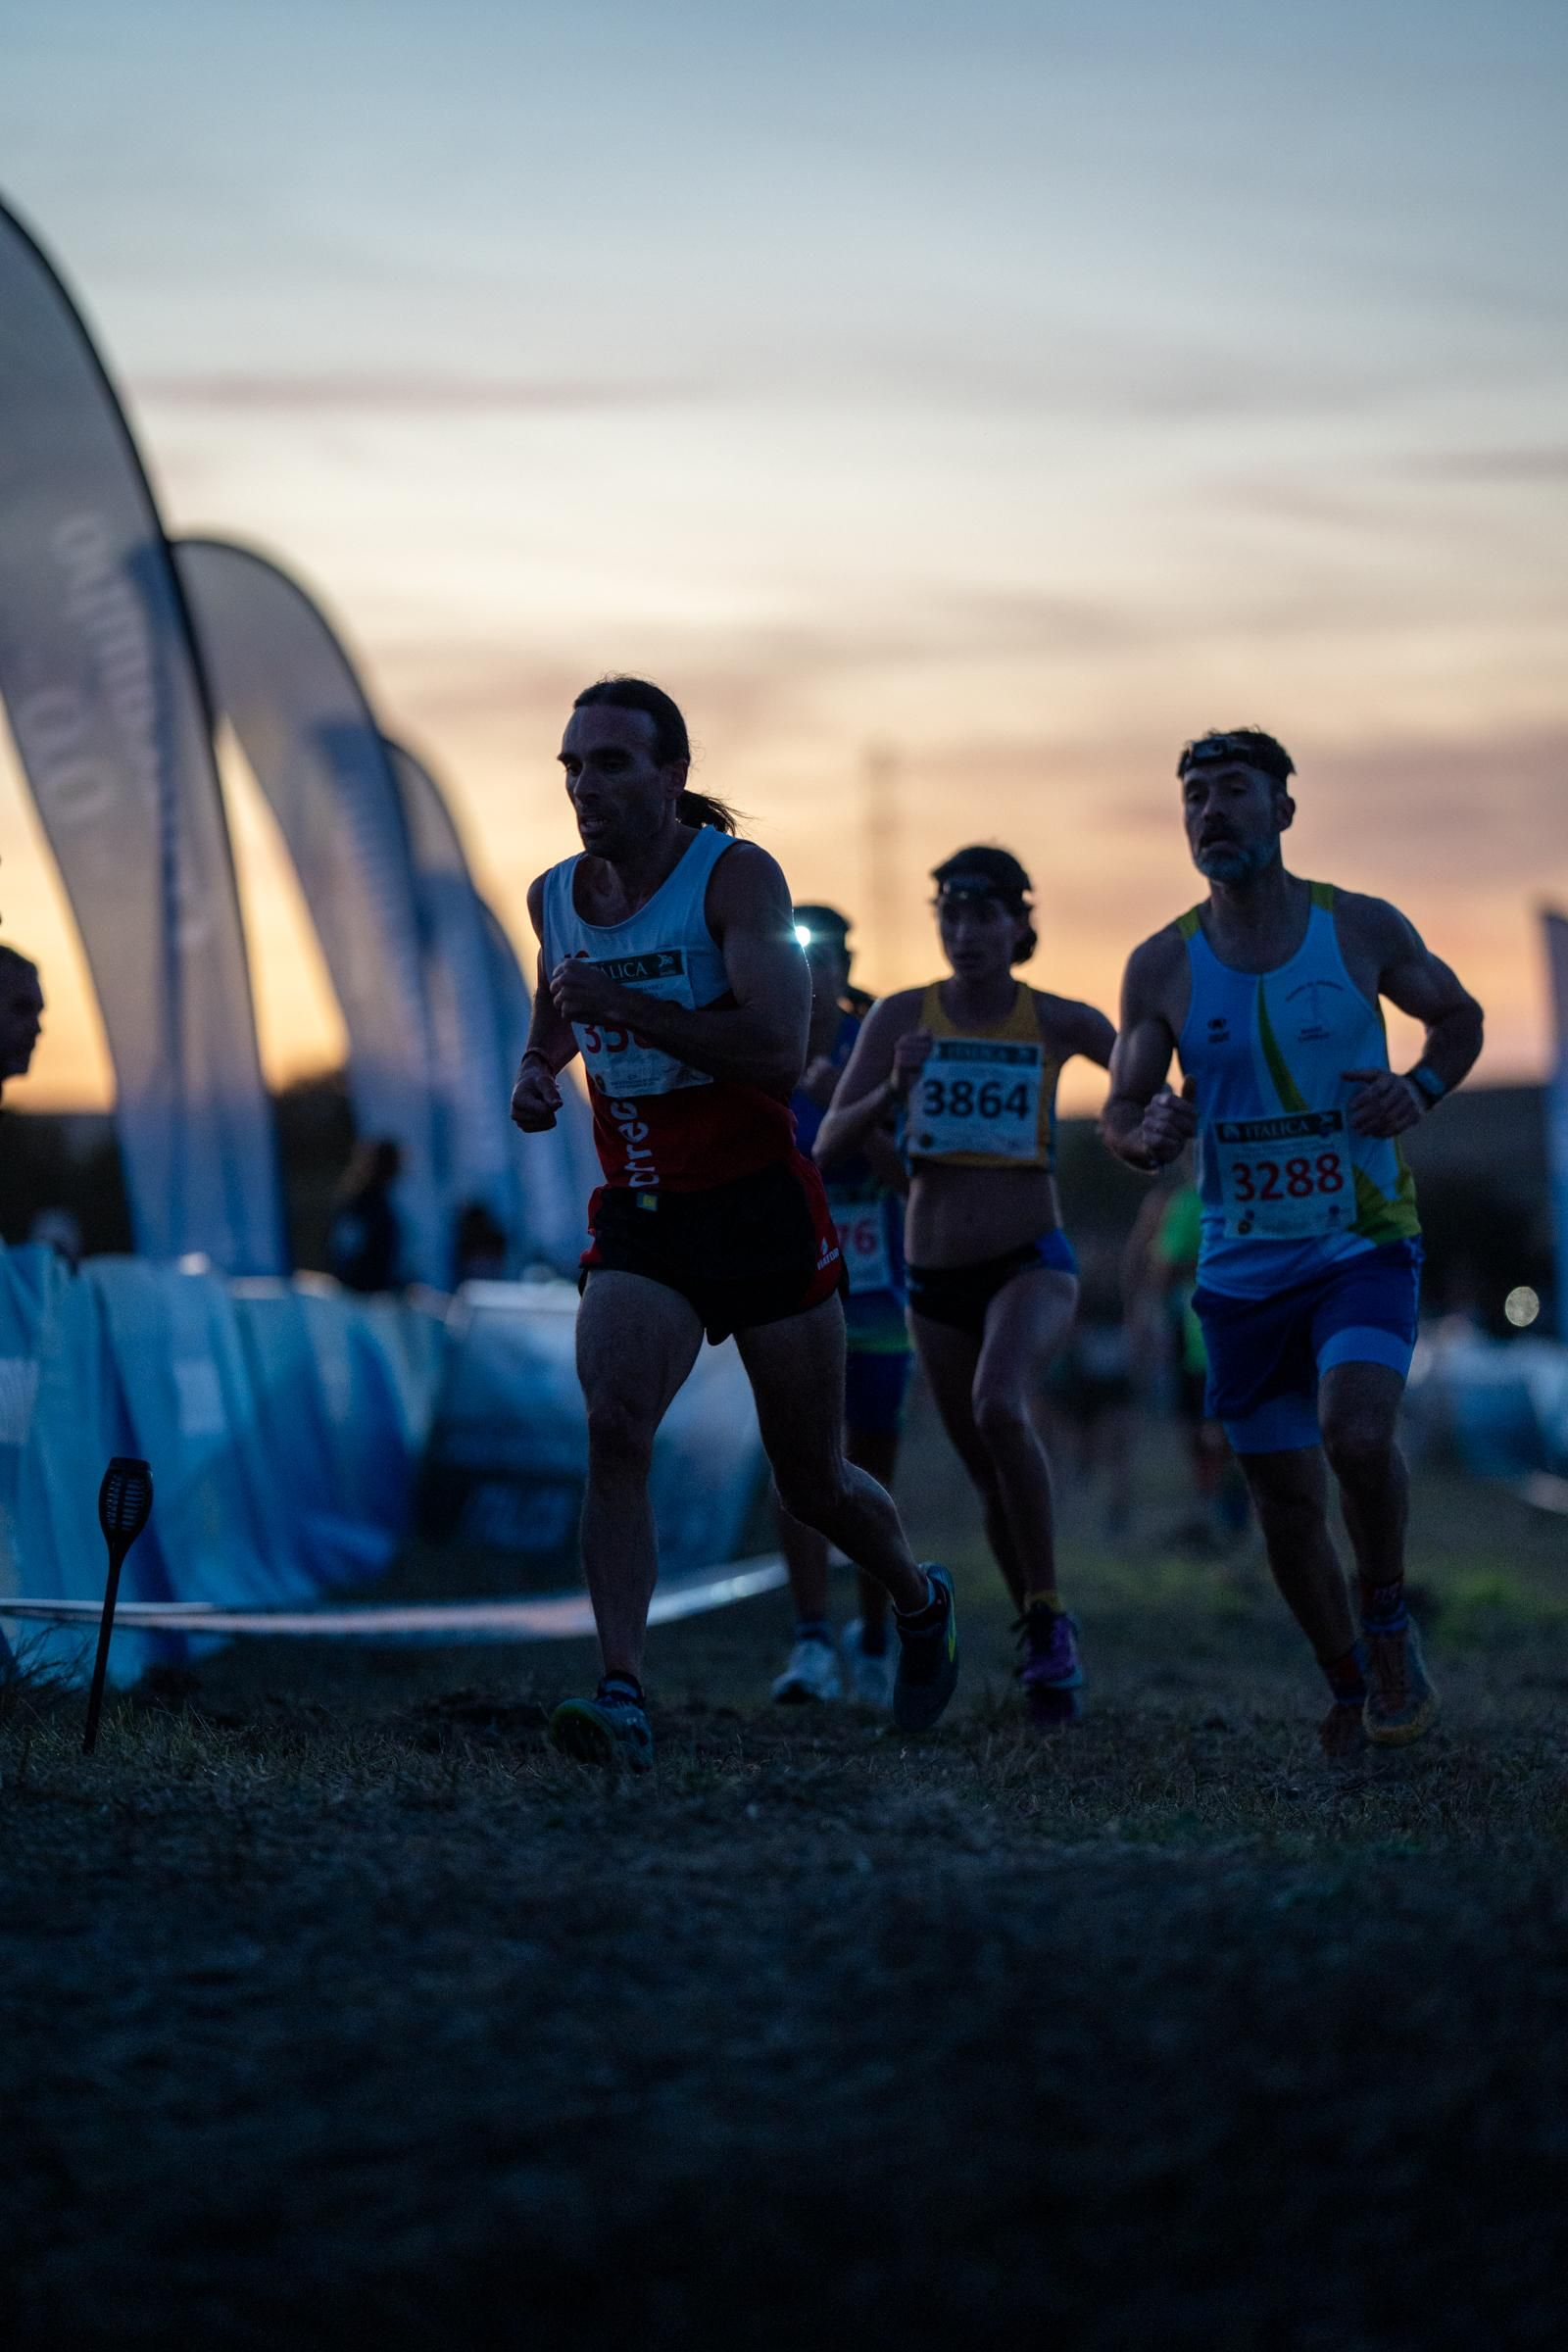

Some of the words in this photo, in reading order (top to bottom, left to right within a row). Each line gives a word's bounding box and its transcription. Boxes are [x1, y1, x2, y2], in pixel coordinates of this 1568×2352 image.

[586, 1023, 659, 1053] 35
[924, 1079, 1028, 1121] 3864
[1233, 1153, 1344, 1201] 3288
